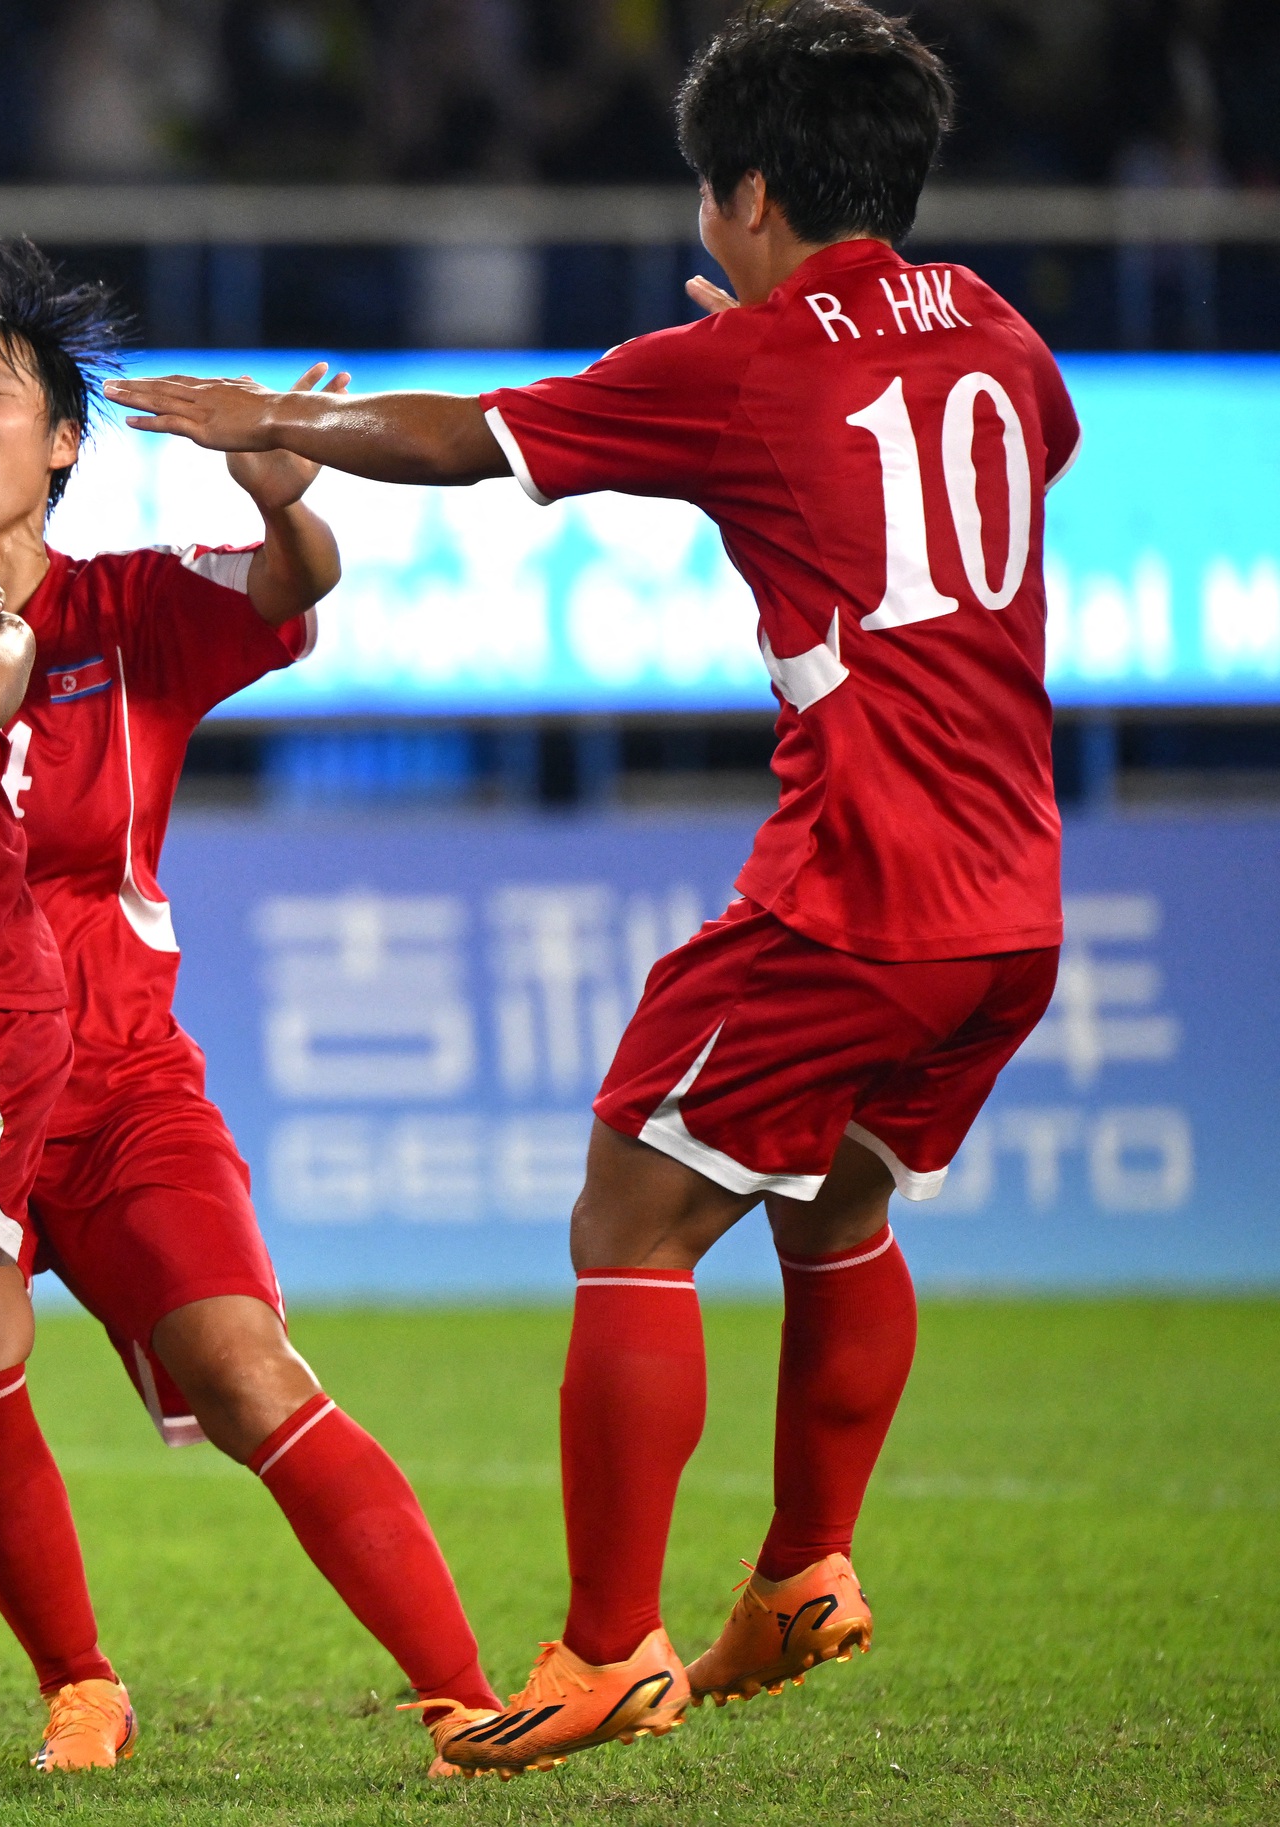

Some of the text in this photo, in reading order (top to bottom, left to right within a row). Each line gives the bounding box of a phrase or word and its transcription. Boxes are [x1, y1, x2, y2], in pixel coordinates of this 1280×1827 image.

[846, 371, 1031, 631] 10
[252, 880, 1182, 1100] 吉利车
